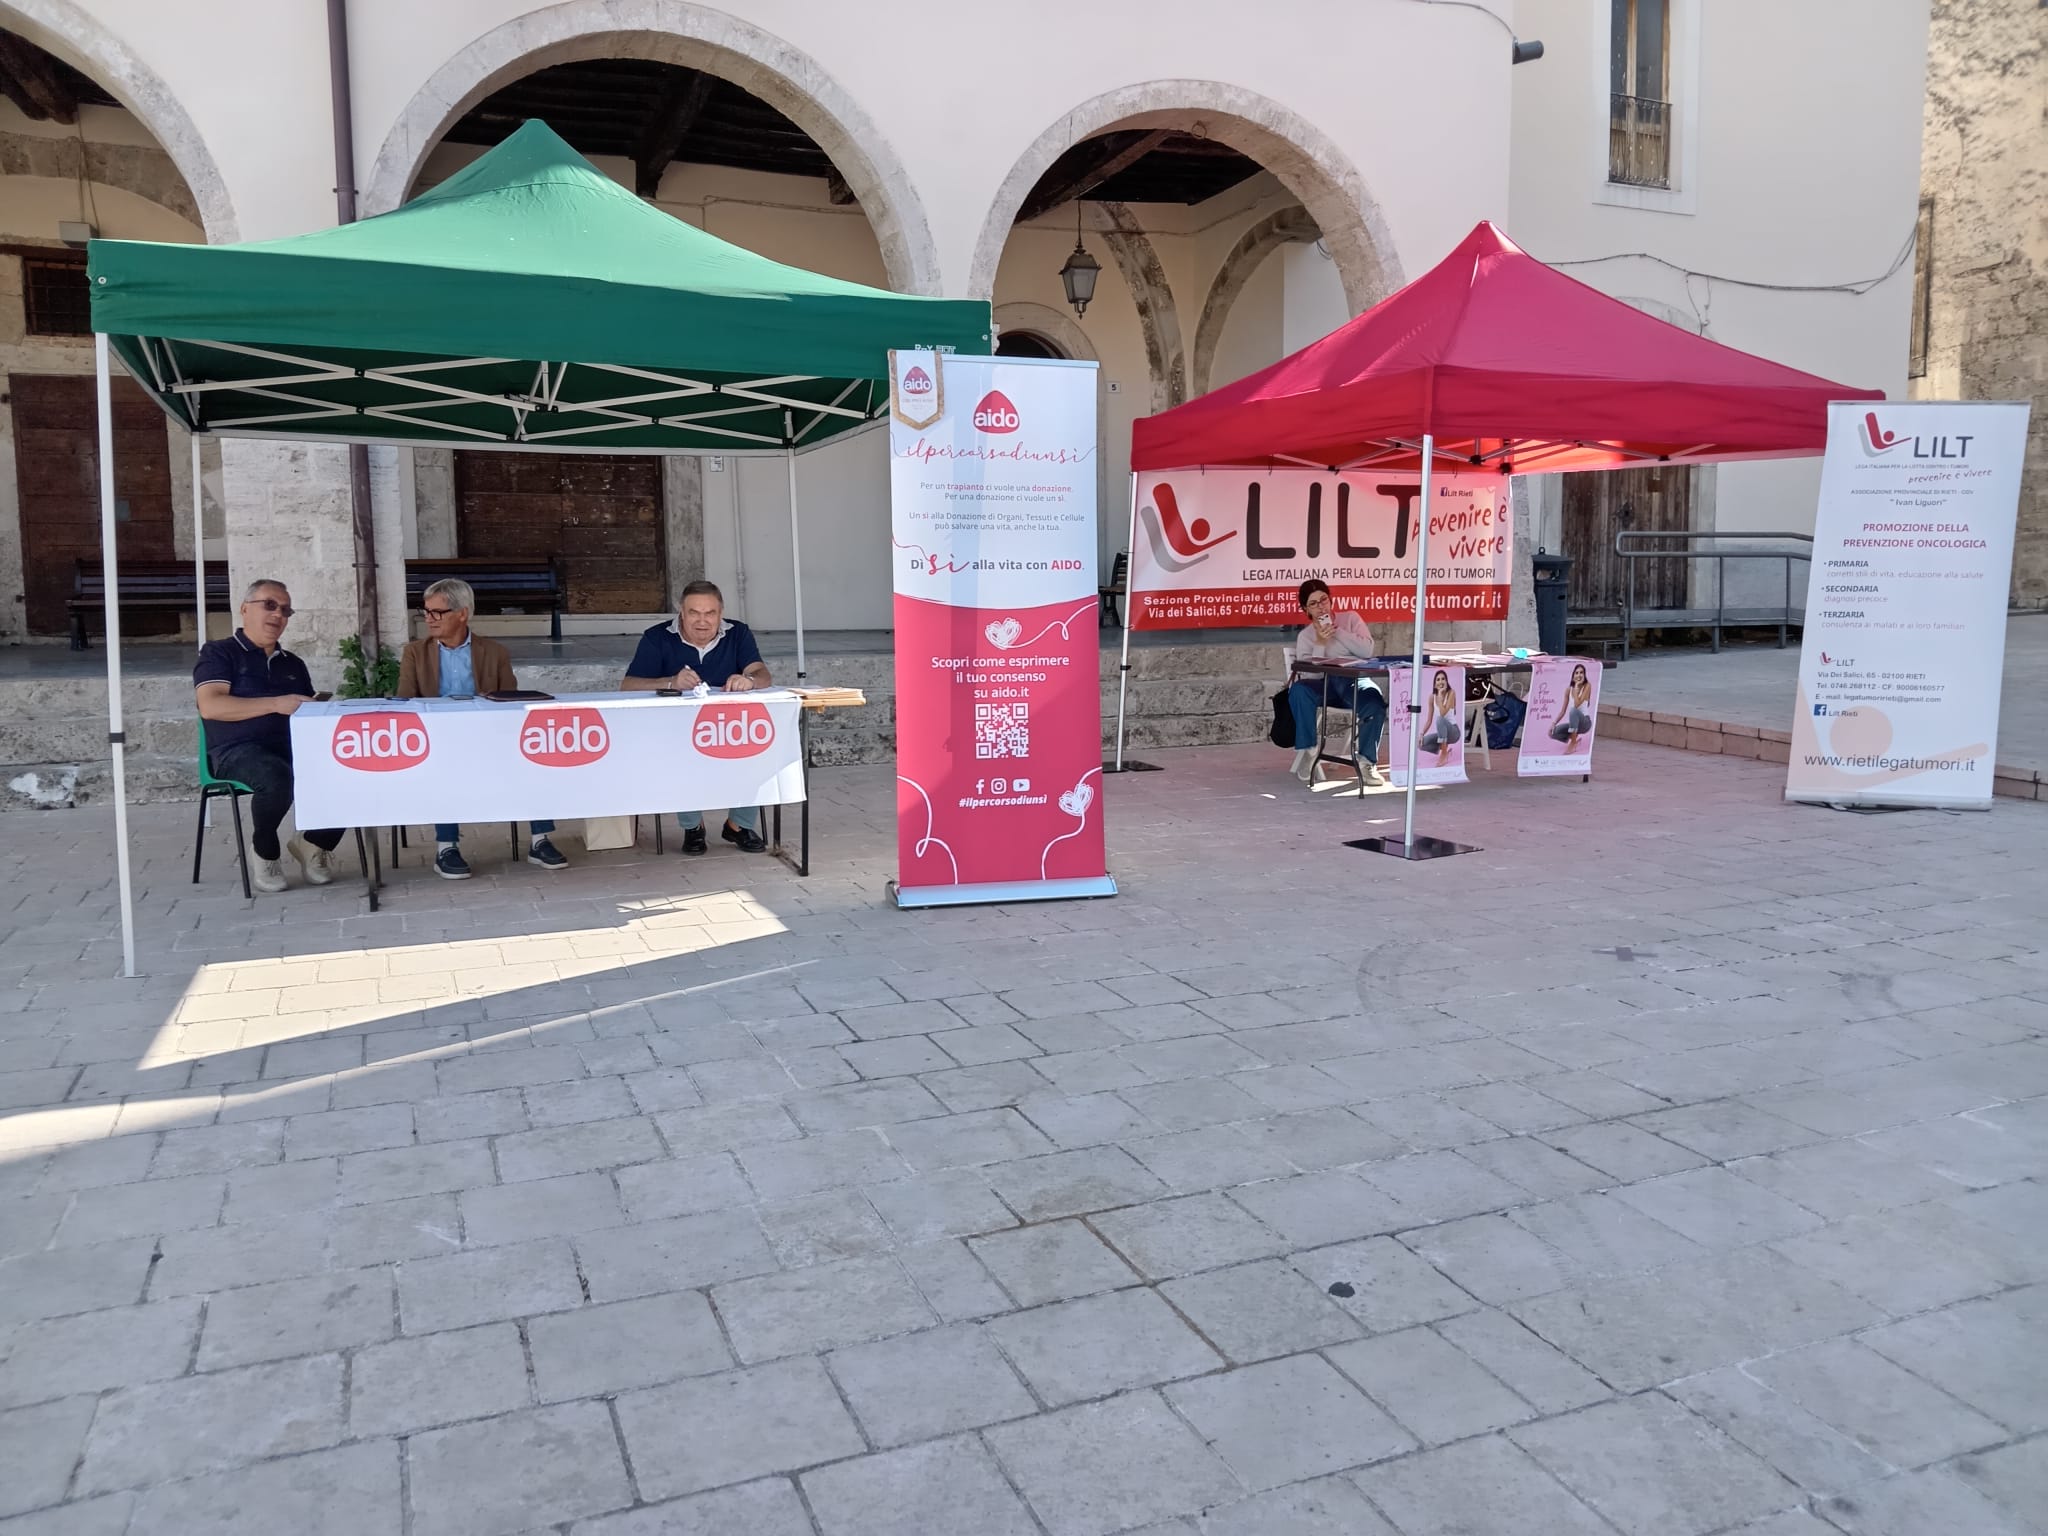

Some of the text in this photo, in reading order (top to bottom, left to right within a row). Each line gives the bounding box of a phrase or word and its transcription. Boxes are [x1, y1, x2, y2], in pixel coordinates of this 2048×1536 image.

[905, 378, 930, 390] aido
[974, 408, 1019, 427] aido
[1913, 436, 1973, 458] LILT
[1908, 473, 1951, 483] prevenire
[1963, 469, 1992, 478] vivere
[947, 483, 984, 492] trapianto
[976, 493, 1014, 501] donazione
[997, 514, 1024, 522] Organi,
[1246, 481, 1420, 560] LILT
[1411, 497, 1507, 542] pevenire è
[935, 522, 949, 530] può
[1014, 523, 1036, 531] anche
[1038, 523, 1045, 531] la
[1863, 523, 1969, 533] PROMOZIONE DELLA
[1449, 535, 1504, 559] vivere
[1843, 539, 1986, 548] PREVENZIONE ONCOLOGICA
[972, 559, 995, 570] alla
[999, 559, 1022, 570] vita
[1026, 561, 1048, 570] con
[1051, 559, 1085, 570] AIDO.
[1243, 570, 1272, 580] LEGA
[1276, 568, 1329, 580] ITALIANA
[1333, 568, 1352, 579] PER
[1354, 568, 1365, 578] LA
[1367, 568, 1400, 579] LOTTA
[1403, 568, 1445, 579] COTRO
[1454, 568, 1496, 579] TUMORI
[1144, 592, 1299, 606] Sezione Provinciale di RIE
[1149, 608, 1164, 618] Via
[1167, 606, 1183, 618] dei
[931, 655, 1069, 670] Scopri come esprimere
[956, 671, 1046, 683] il tuo consenso
[974, 686, 1029, 698] su aido.it
[694, 708, 773, 748] aido
[335, 718, 427, 759] aido
[523, 716, 607, 755] aido
[1804, 754, 1975, 772] www.rietilegatumori.it
